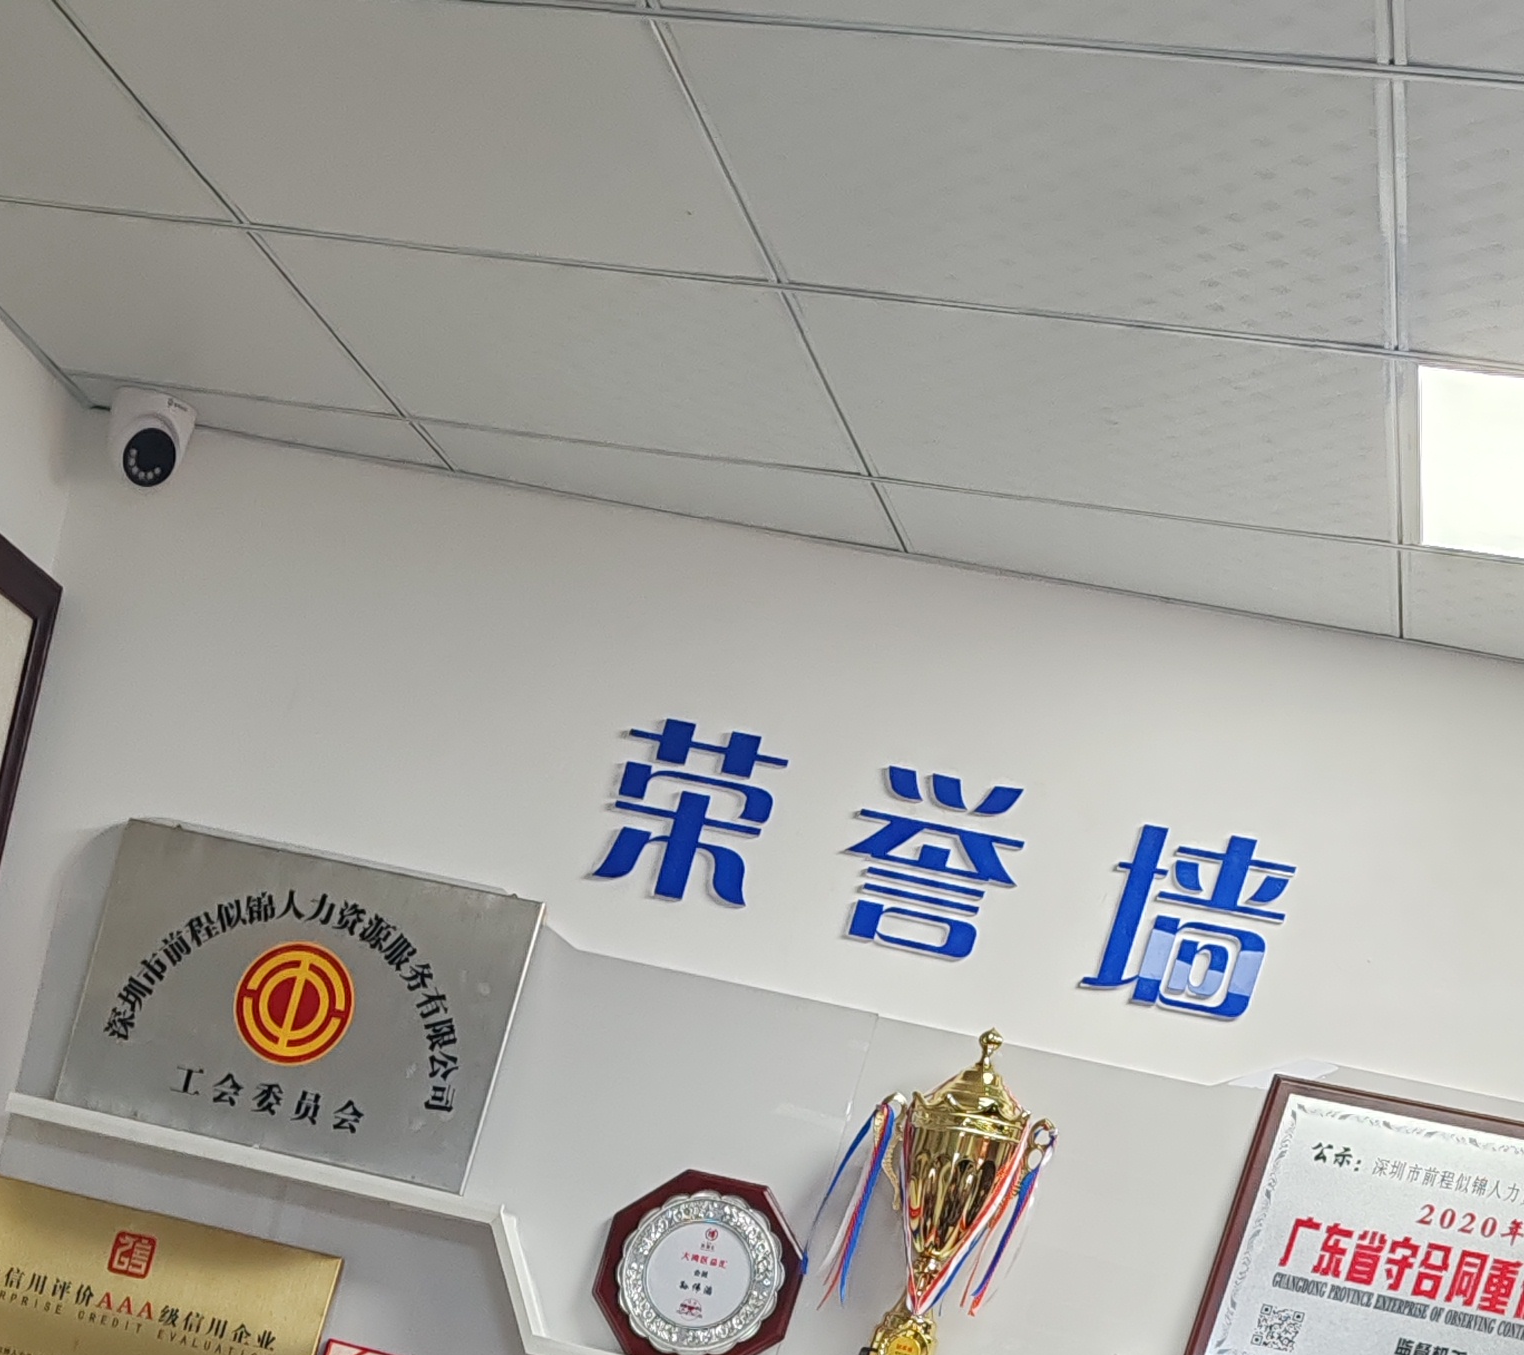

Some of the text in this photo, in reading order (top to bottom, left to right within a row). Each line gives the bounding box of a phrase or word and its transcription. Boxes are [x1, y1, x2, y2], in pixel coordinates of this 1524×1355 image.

[590, 718, 1297, 1020] 荣誉墙
[103, 889, 459, 1114] 深圳市前程似锦人力资源服务有限公司
[171, 1065, 365, 1134] 工会委员会
[1371, 1157, 1524, 1205] 深圳市前程似锦人力
[1279, 1216, 1524, 1320] 广东省守合同重
[77, 1310, 143, 1335] CREDIT
[1272, 1271, 1327, 1298] GUANGDONG
[1329, 1286, 1374, 1309] PROVINCE
[1373, 1293, 1430, 1320] ENTERPRISE
[1429, 1305, 1445, 1324] OF
[1444, 1309, 1497, 1335] OBSERVING
